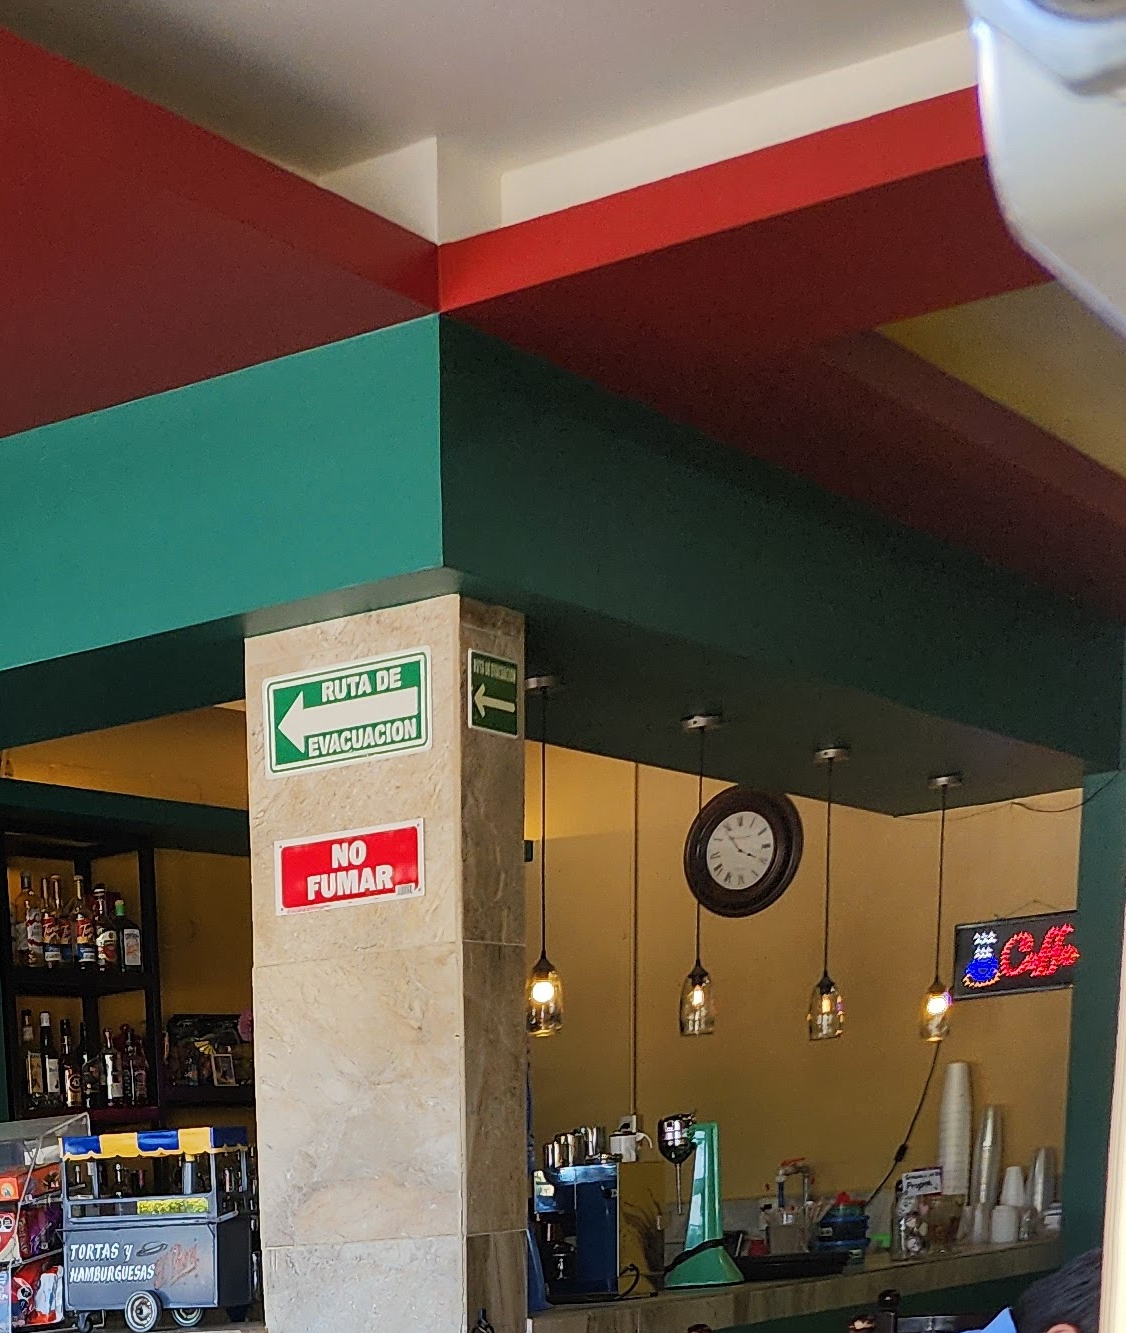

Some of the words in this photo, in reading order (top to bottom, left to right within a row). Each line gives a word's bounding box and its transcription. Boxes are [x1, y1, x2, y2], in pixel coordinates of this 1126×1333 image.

[321, 673, 372, 702] RUTA
[375, 667, 402, 692] DE
[308, 718, 417, 757] EVACUACION
[331, 839, 367, 868] NO
[307, 865, 393, 900] FUMAR
[69, 1242, 119, 1261] TORTAS
[69, 1263, 156, 1283] HAMBURGUESAS
